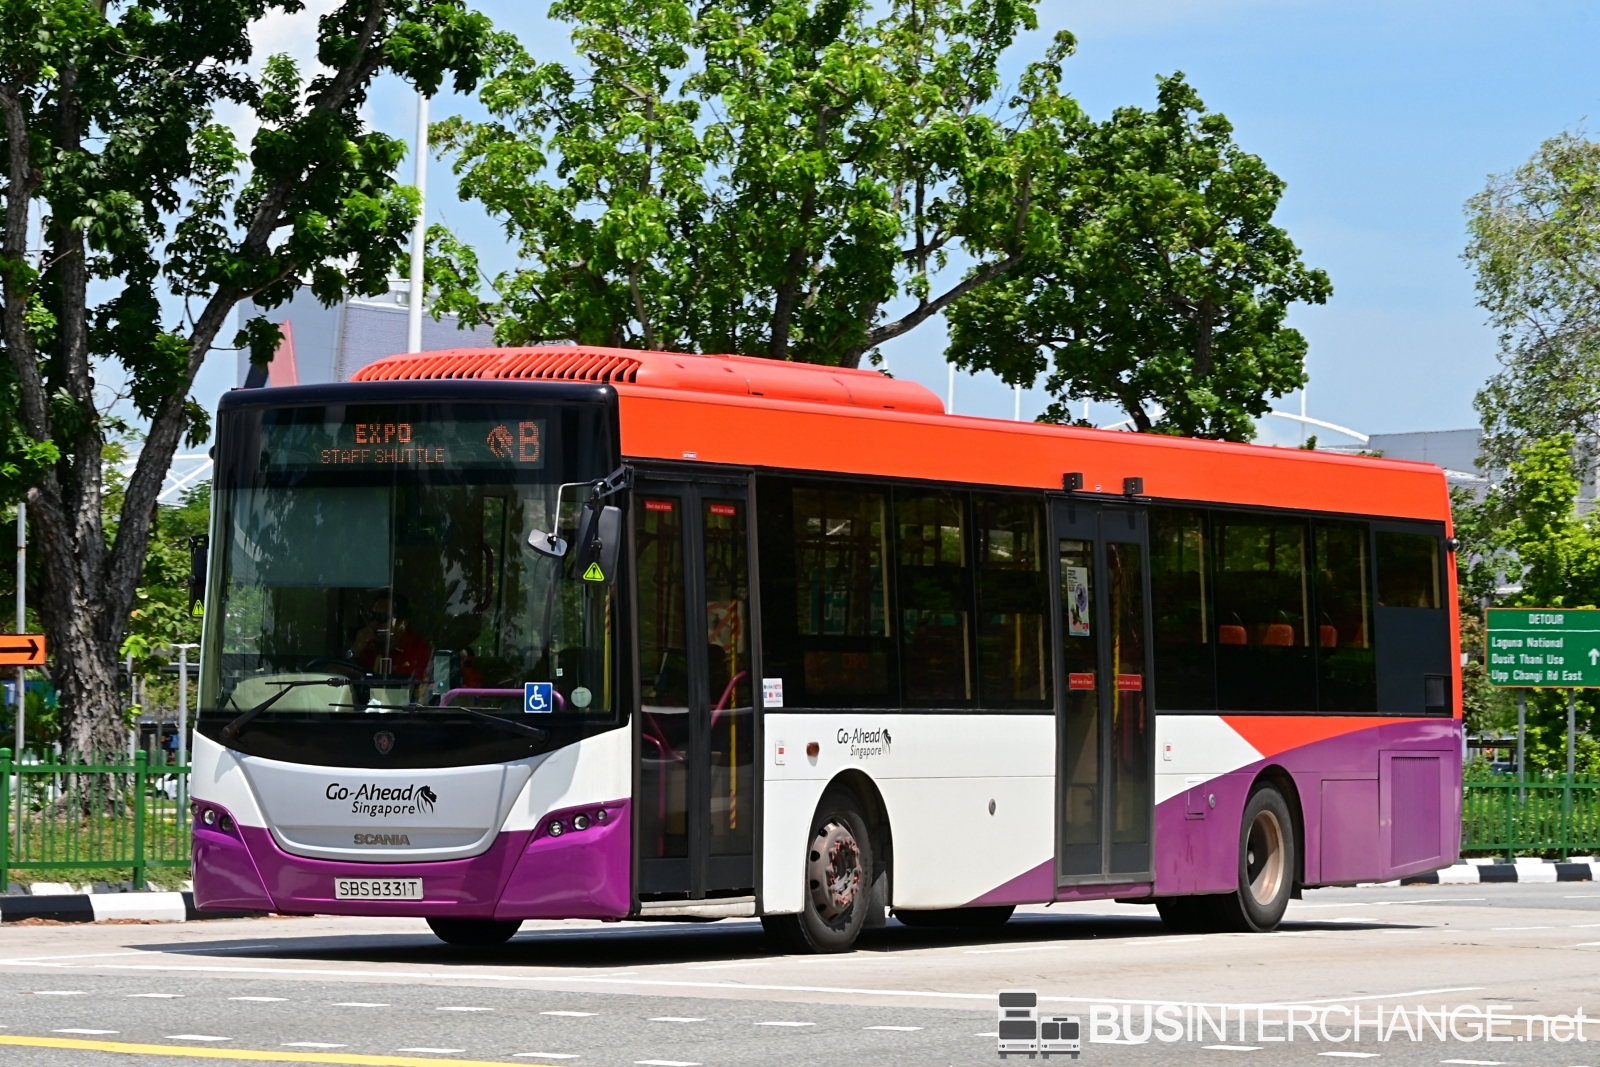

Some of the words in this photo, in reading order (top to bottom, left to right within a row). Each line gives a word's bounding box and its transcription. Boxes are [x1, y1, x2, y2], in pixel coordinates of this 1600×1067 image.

[355, 423, 411, 443] EXPO
[519, 421, 539, 462] B
[321, 449, 370, 464] STAFF
[374, 448, 445, 463] SHUTTLE
[1528, 613, 1564, 625] DETOUR
[1491, 636, 1523, 650] Laguna
[1526, 637, 1564, 649] National
[1491, 653, 1516, 665] Dusit
[1519, 653, 1544, 665] Thani
[1546, 654, 1565, 665] Use
[1491, 669, 1509, 683] Upp
[1512, 669, 1544, 683] Changi
[1546, 670, 1559, 681] Rd
[1561, 670, 1583, 681] East
[837, 728, 881, 744] Go-Ahead
[850, 745, 882, 759] Singapore
[326, 783, 414, 801] Go-Ahead
[352, 801, 415, 817] Singapore
[353, 833, 411, 846] SCANIA
[339, 881, 418, 897] SBS8331T
